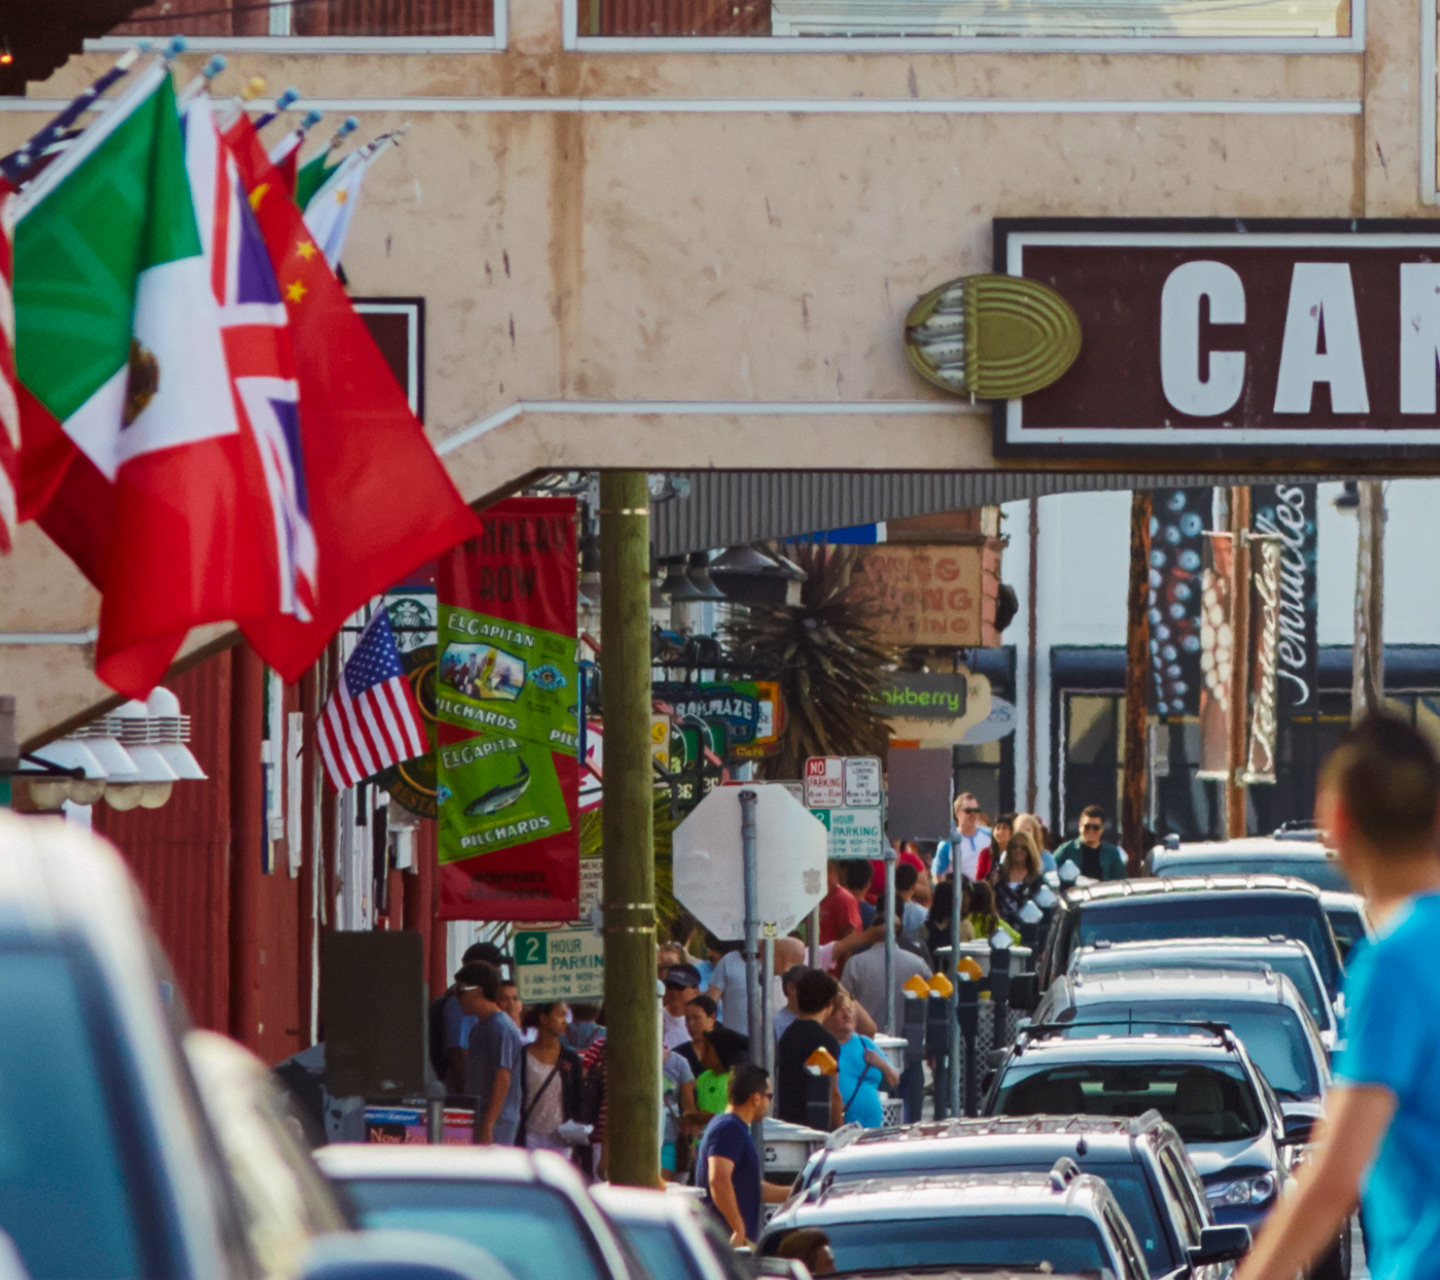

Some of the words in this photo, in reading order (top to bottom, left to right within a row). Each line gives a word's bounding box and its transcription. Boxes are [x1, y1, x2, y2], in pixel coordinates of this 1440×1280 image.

[478, 564, 537, 602] ROW
[435, 696, 518, 731] ILCHARDS
[809, 762, 825, 775] NO
[810, 777, 842, 789] PARKING
[832, 814, 855, 825] HOUR
[460, 814, 551, 850] PILCHARDS
[832, 826, 879, 837] PARKING
[525, 936, 540, 962] 2
[550, 938, 582, 954] HOUR
